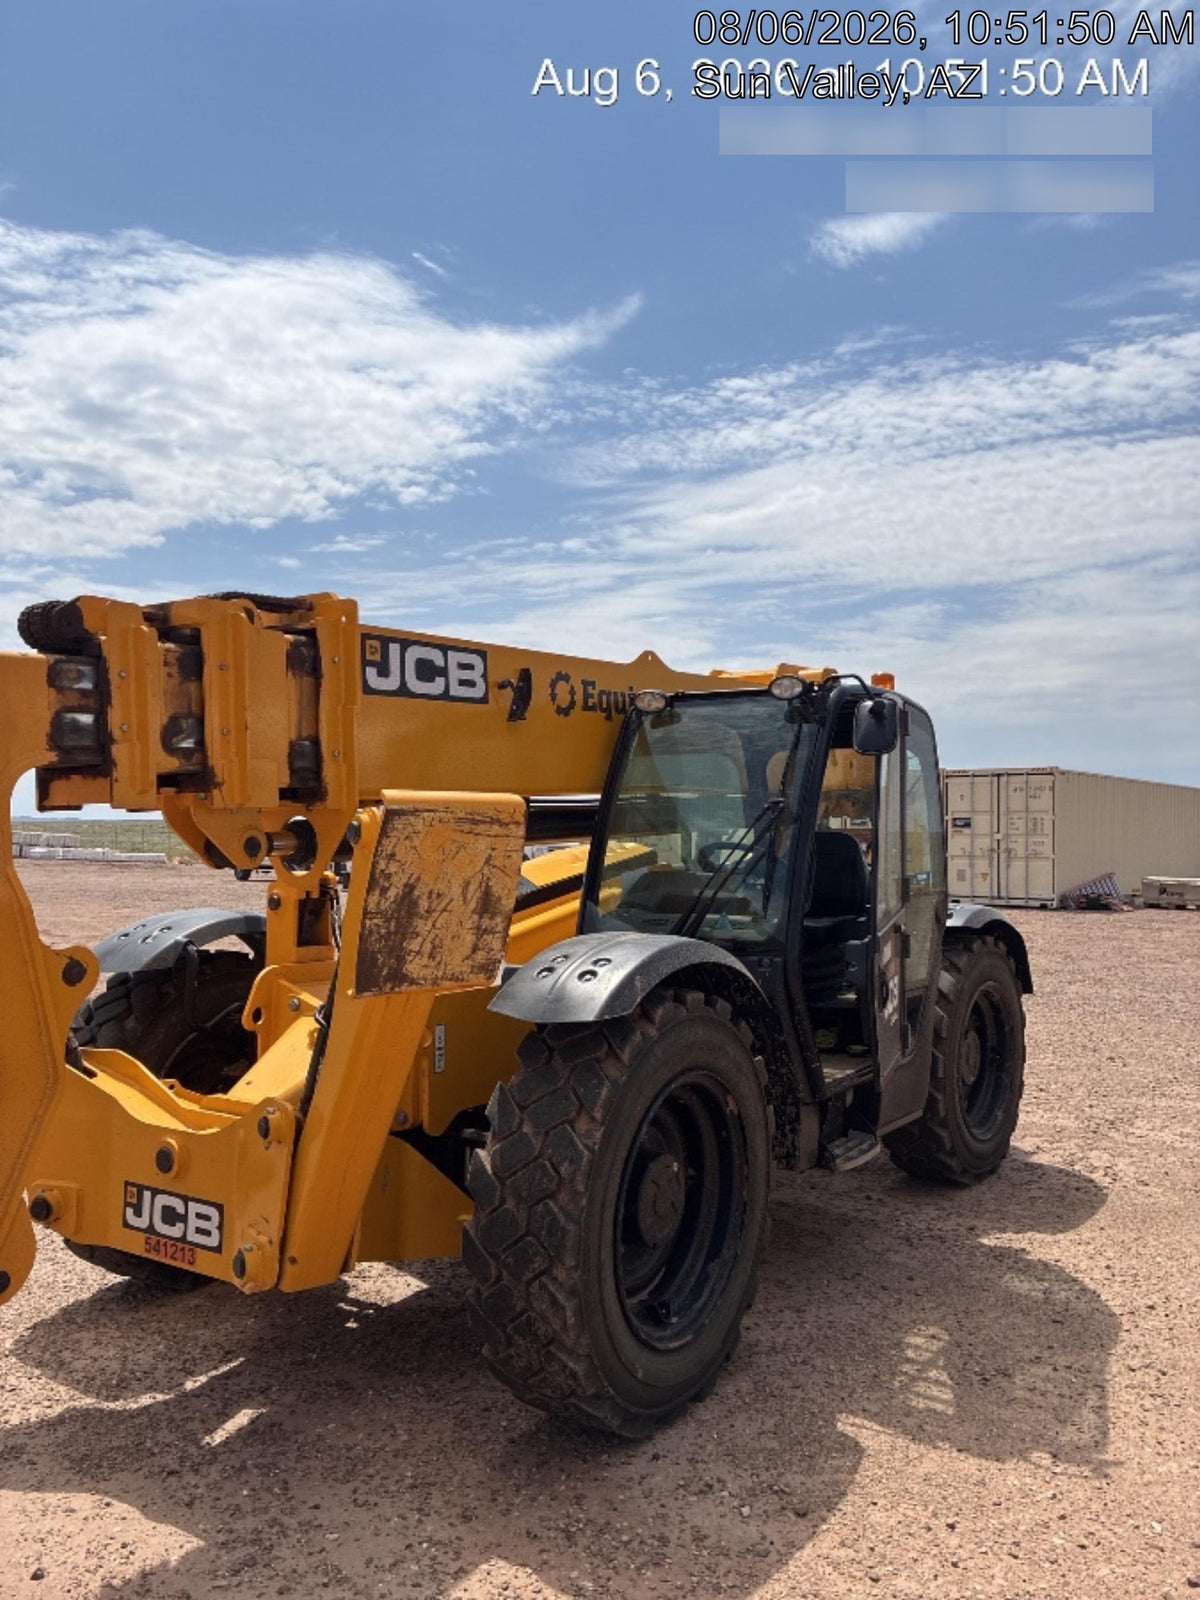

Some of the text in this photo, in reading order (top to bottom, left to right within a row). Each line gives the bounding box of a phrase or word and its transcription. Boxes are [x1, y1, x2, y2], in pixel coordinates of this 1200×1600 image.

[365, 642, 487, 699] JCB
[125, 1190, 220, 1247] JCB
[144, 1237, 197, 1265] 541213
